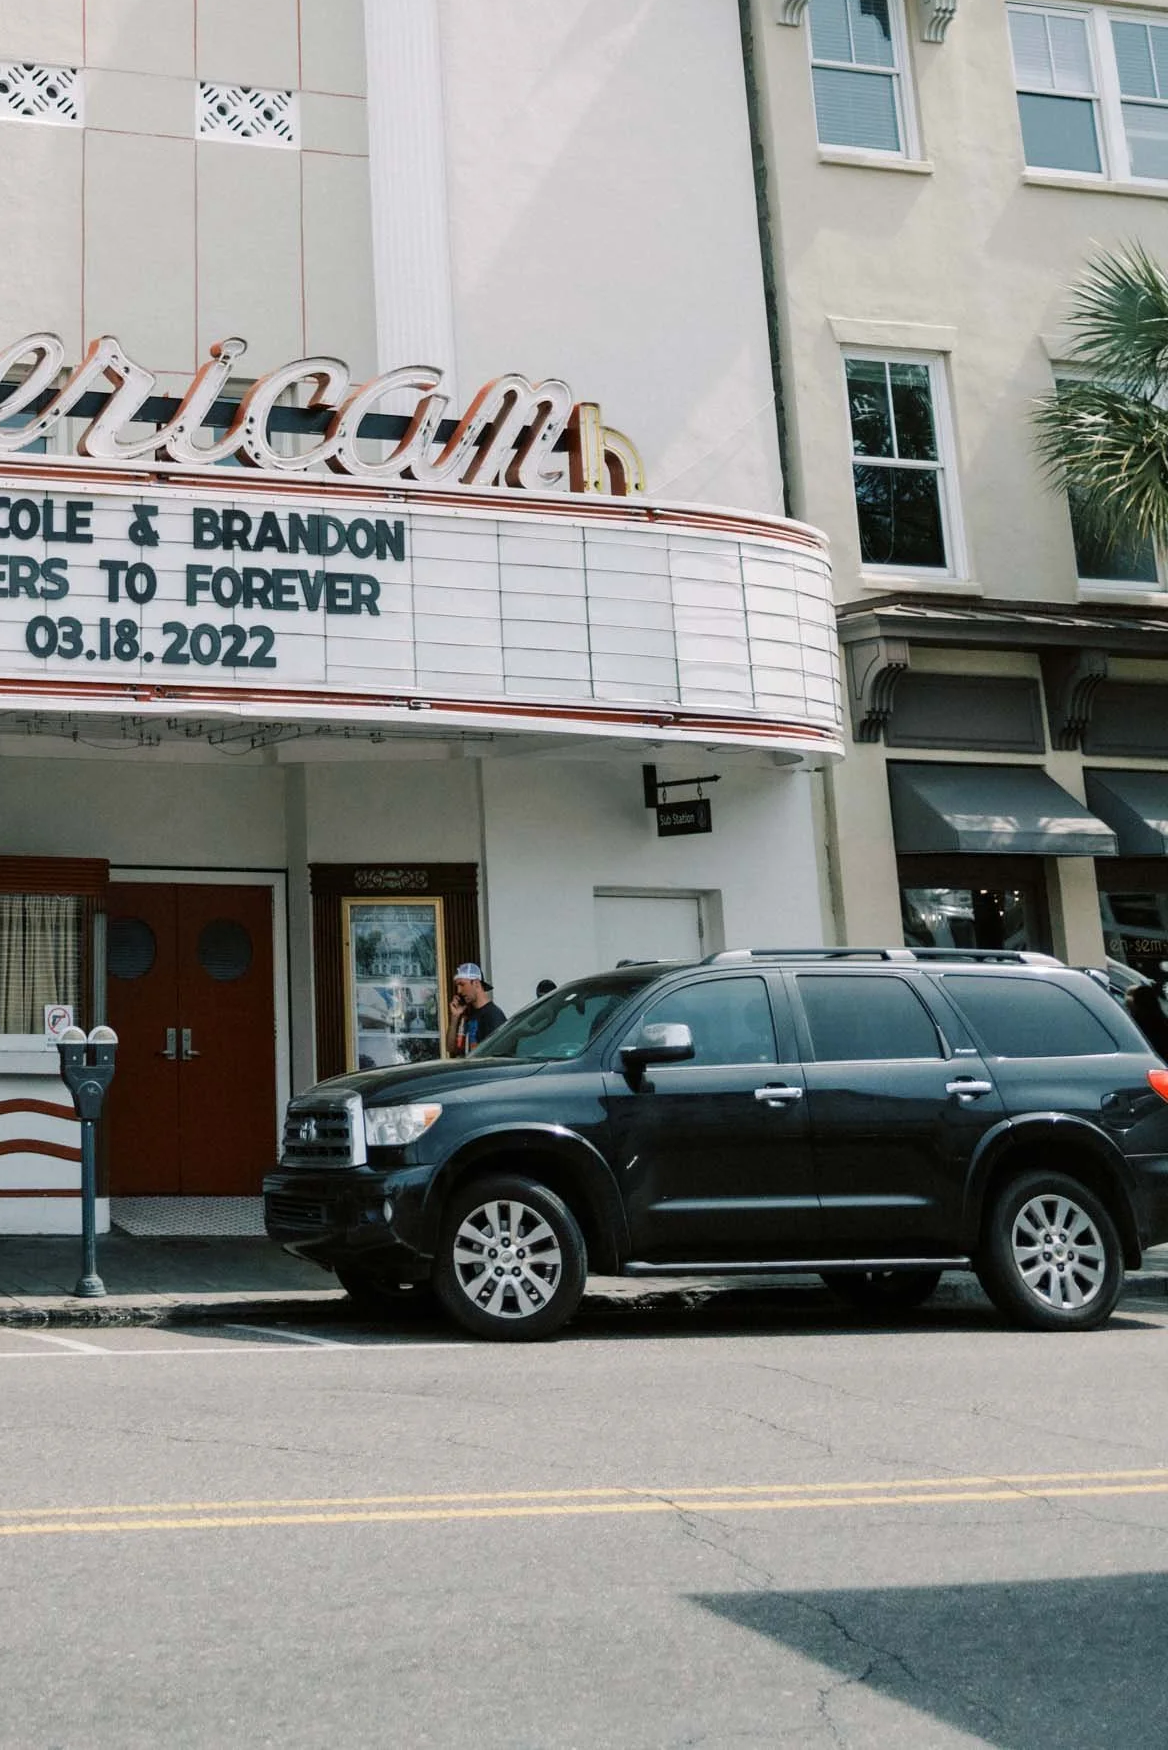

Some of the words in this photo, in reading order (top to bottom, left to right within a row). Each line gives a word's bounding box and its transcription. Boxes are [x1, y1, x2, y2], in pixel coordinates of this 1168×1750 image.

[128, 503, 160, 547] &
[192, 507, 406, 561] BRANDON
[99, 560, 158, 604] TO
[186, 563, 381, 616] FOREVER
[25, 614, 278, 668] 03.18.2022
